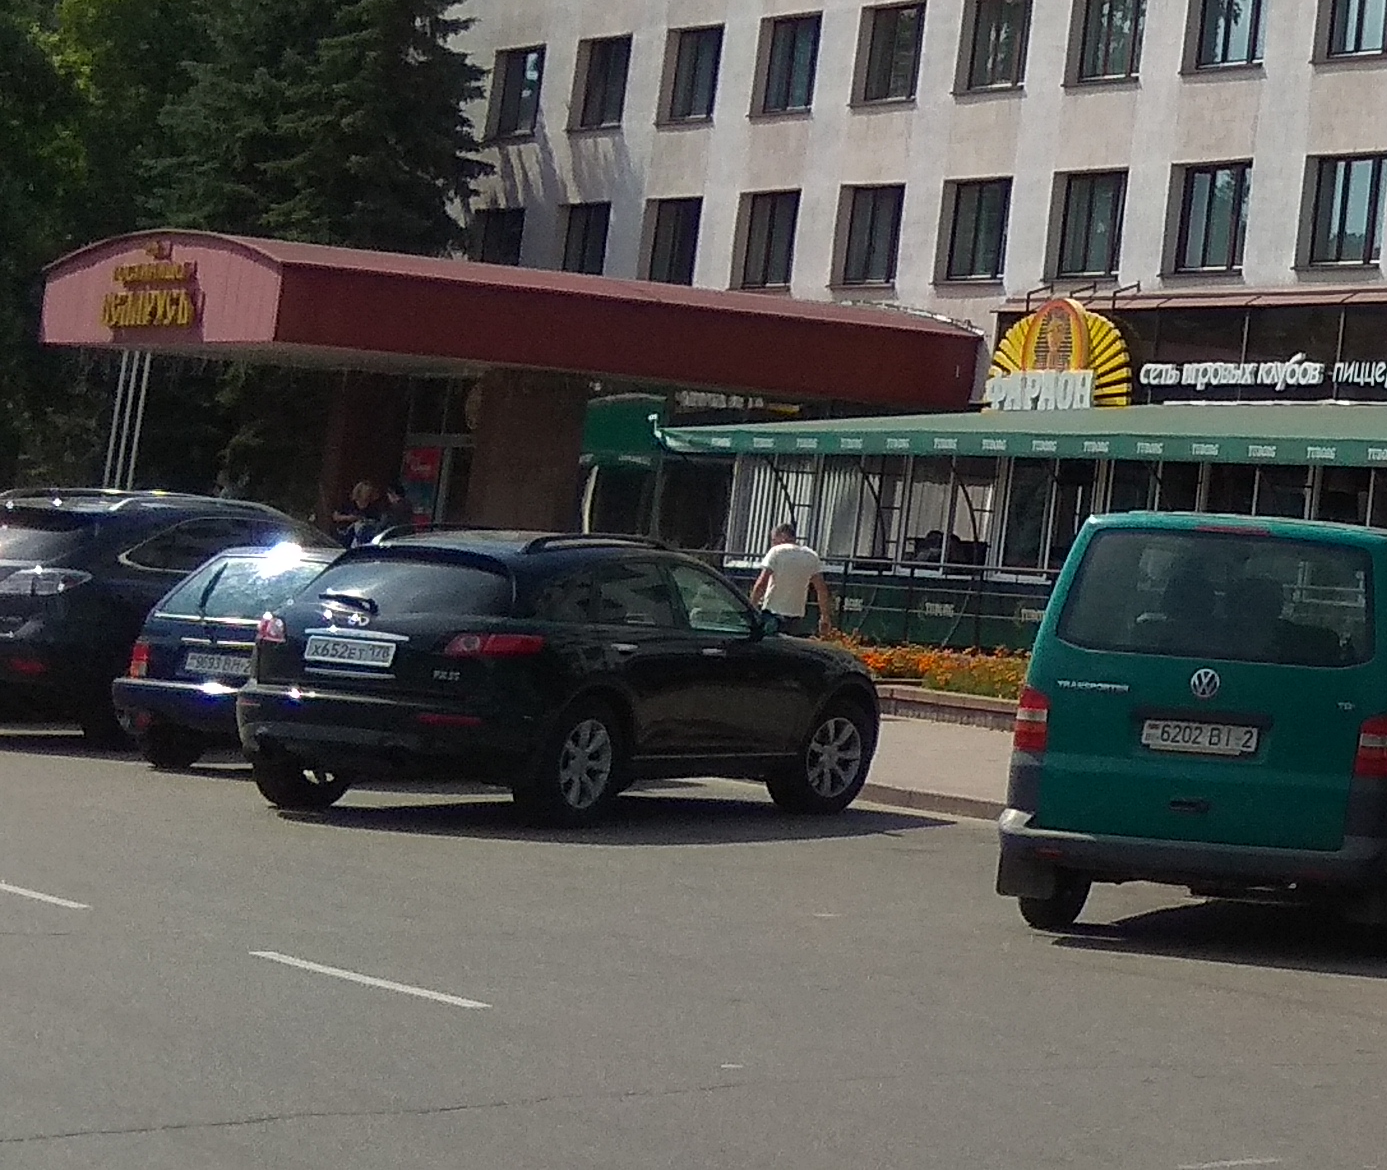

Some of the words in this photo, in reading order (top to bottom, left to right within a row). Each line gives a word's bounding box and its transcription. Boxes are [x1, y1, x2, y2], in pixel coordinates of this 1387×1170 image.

[1181, 361, 1258, 391] игровых
[1257, 352, 1326, 391] клубов
[1160, 723, 1203, 745] 6202
